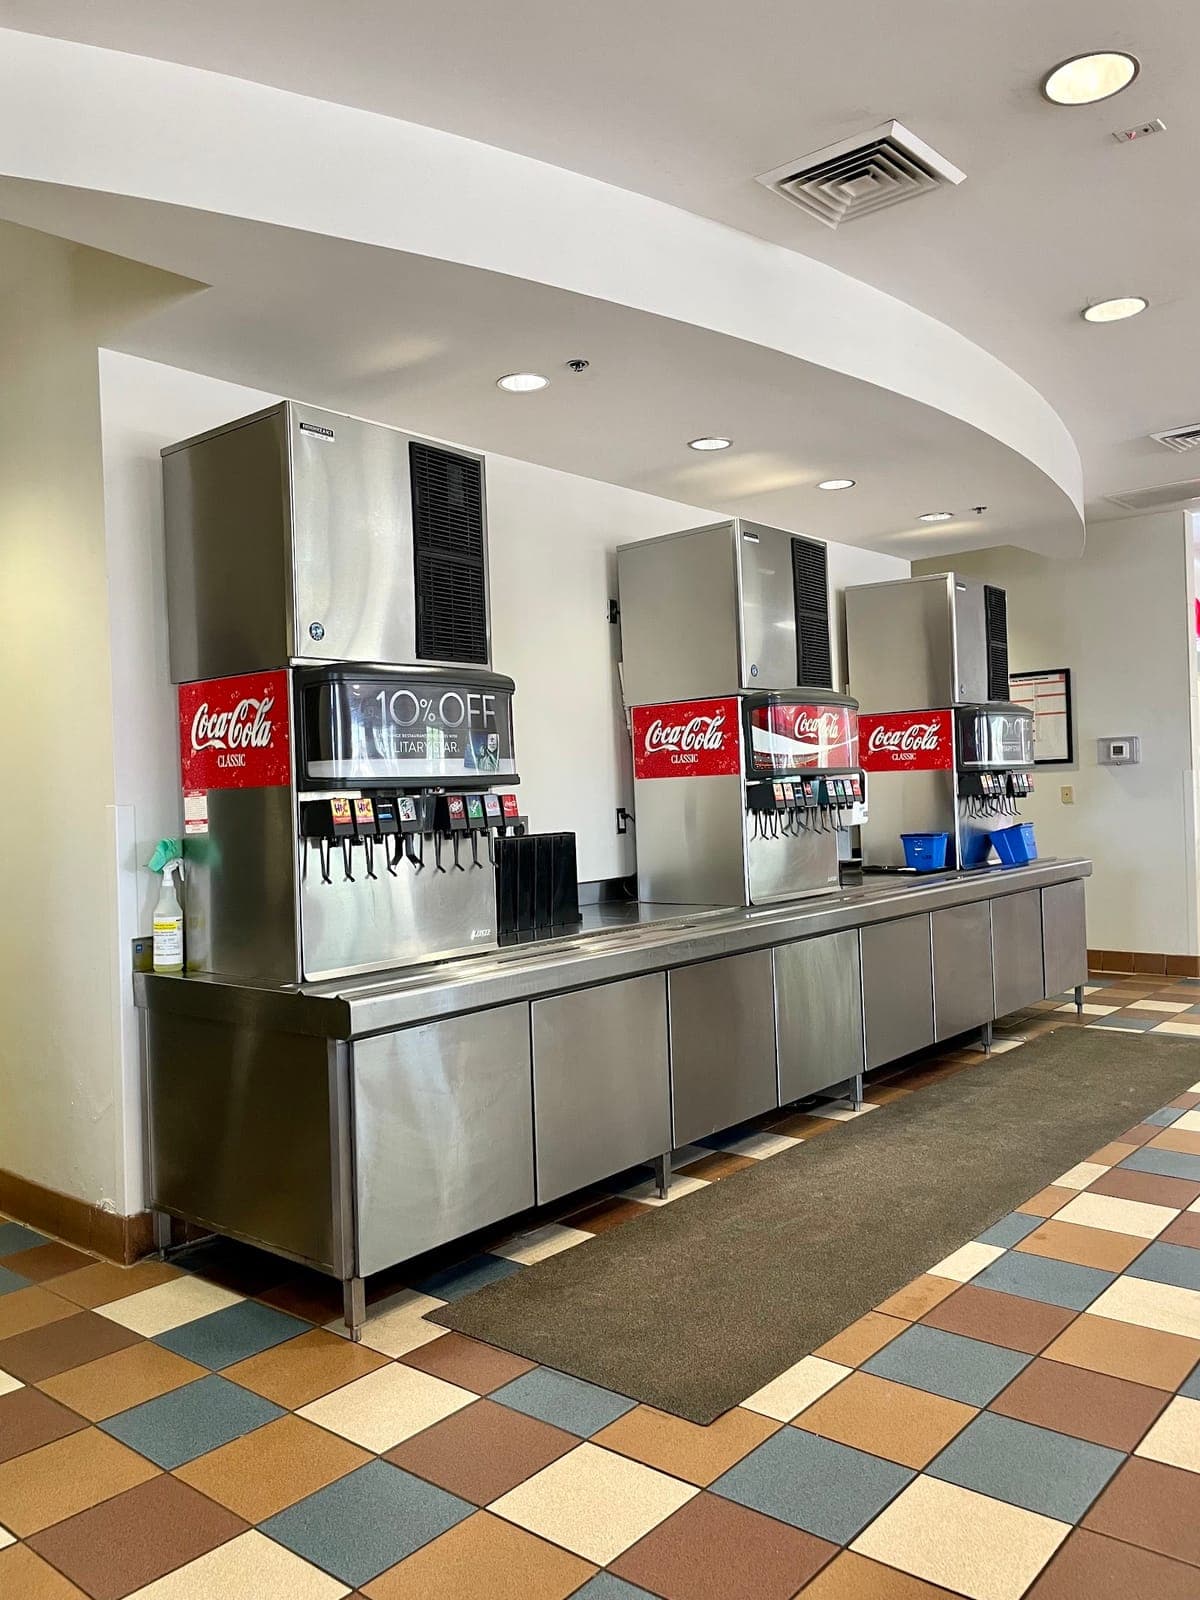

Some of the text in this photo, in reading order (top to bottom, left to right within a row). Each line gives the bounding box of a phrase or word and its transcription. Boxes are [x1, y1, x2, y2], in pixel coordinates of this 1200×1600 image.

[191, 696, 274, 751] Coca-Cola
[376, 689, 496, 729] 10% OFF
[645, 715, 726, 752] Coca-Cola
[868, 723, 941, 752] Coca-Cola
[217, 753, 246, 768] CLASSIC
[671, 754, 699, 764] CLASSIC
[891, 753, 917, 761] CLASSIC
